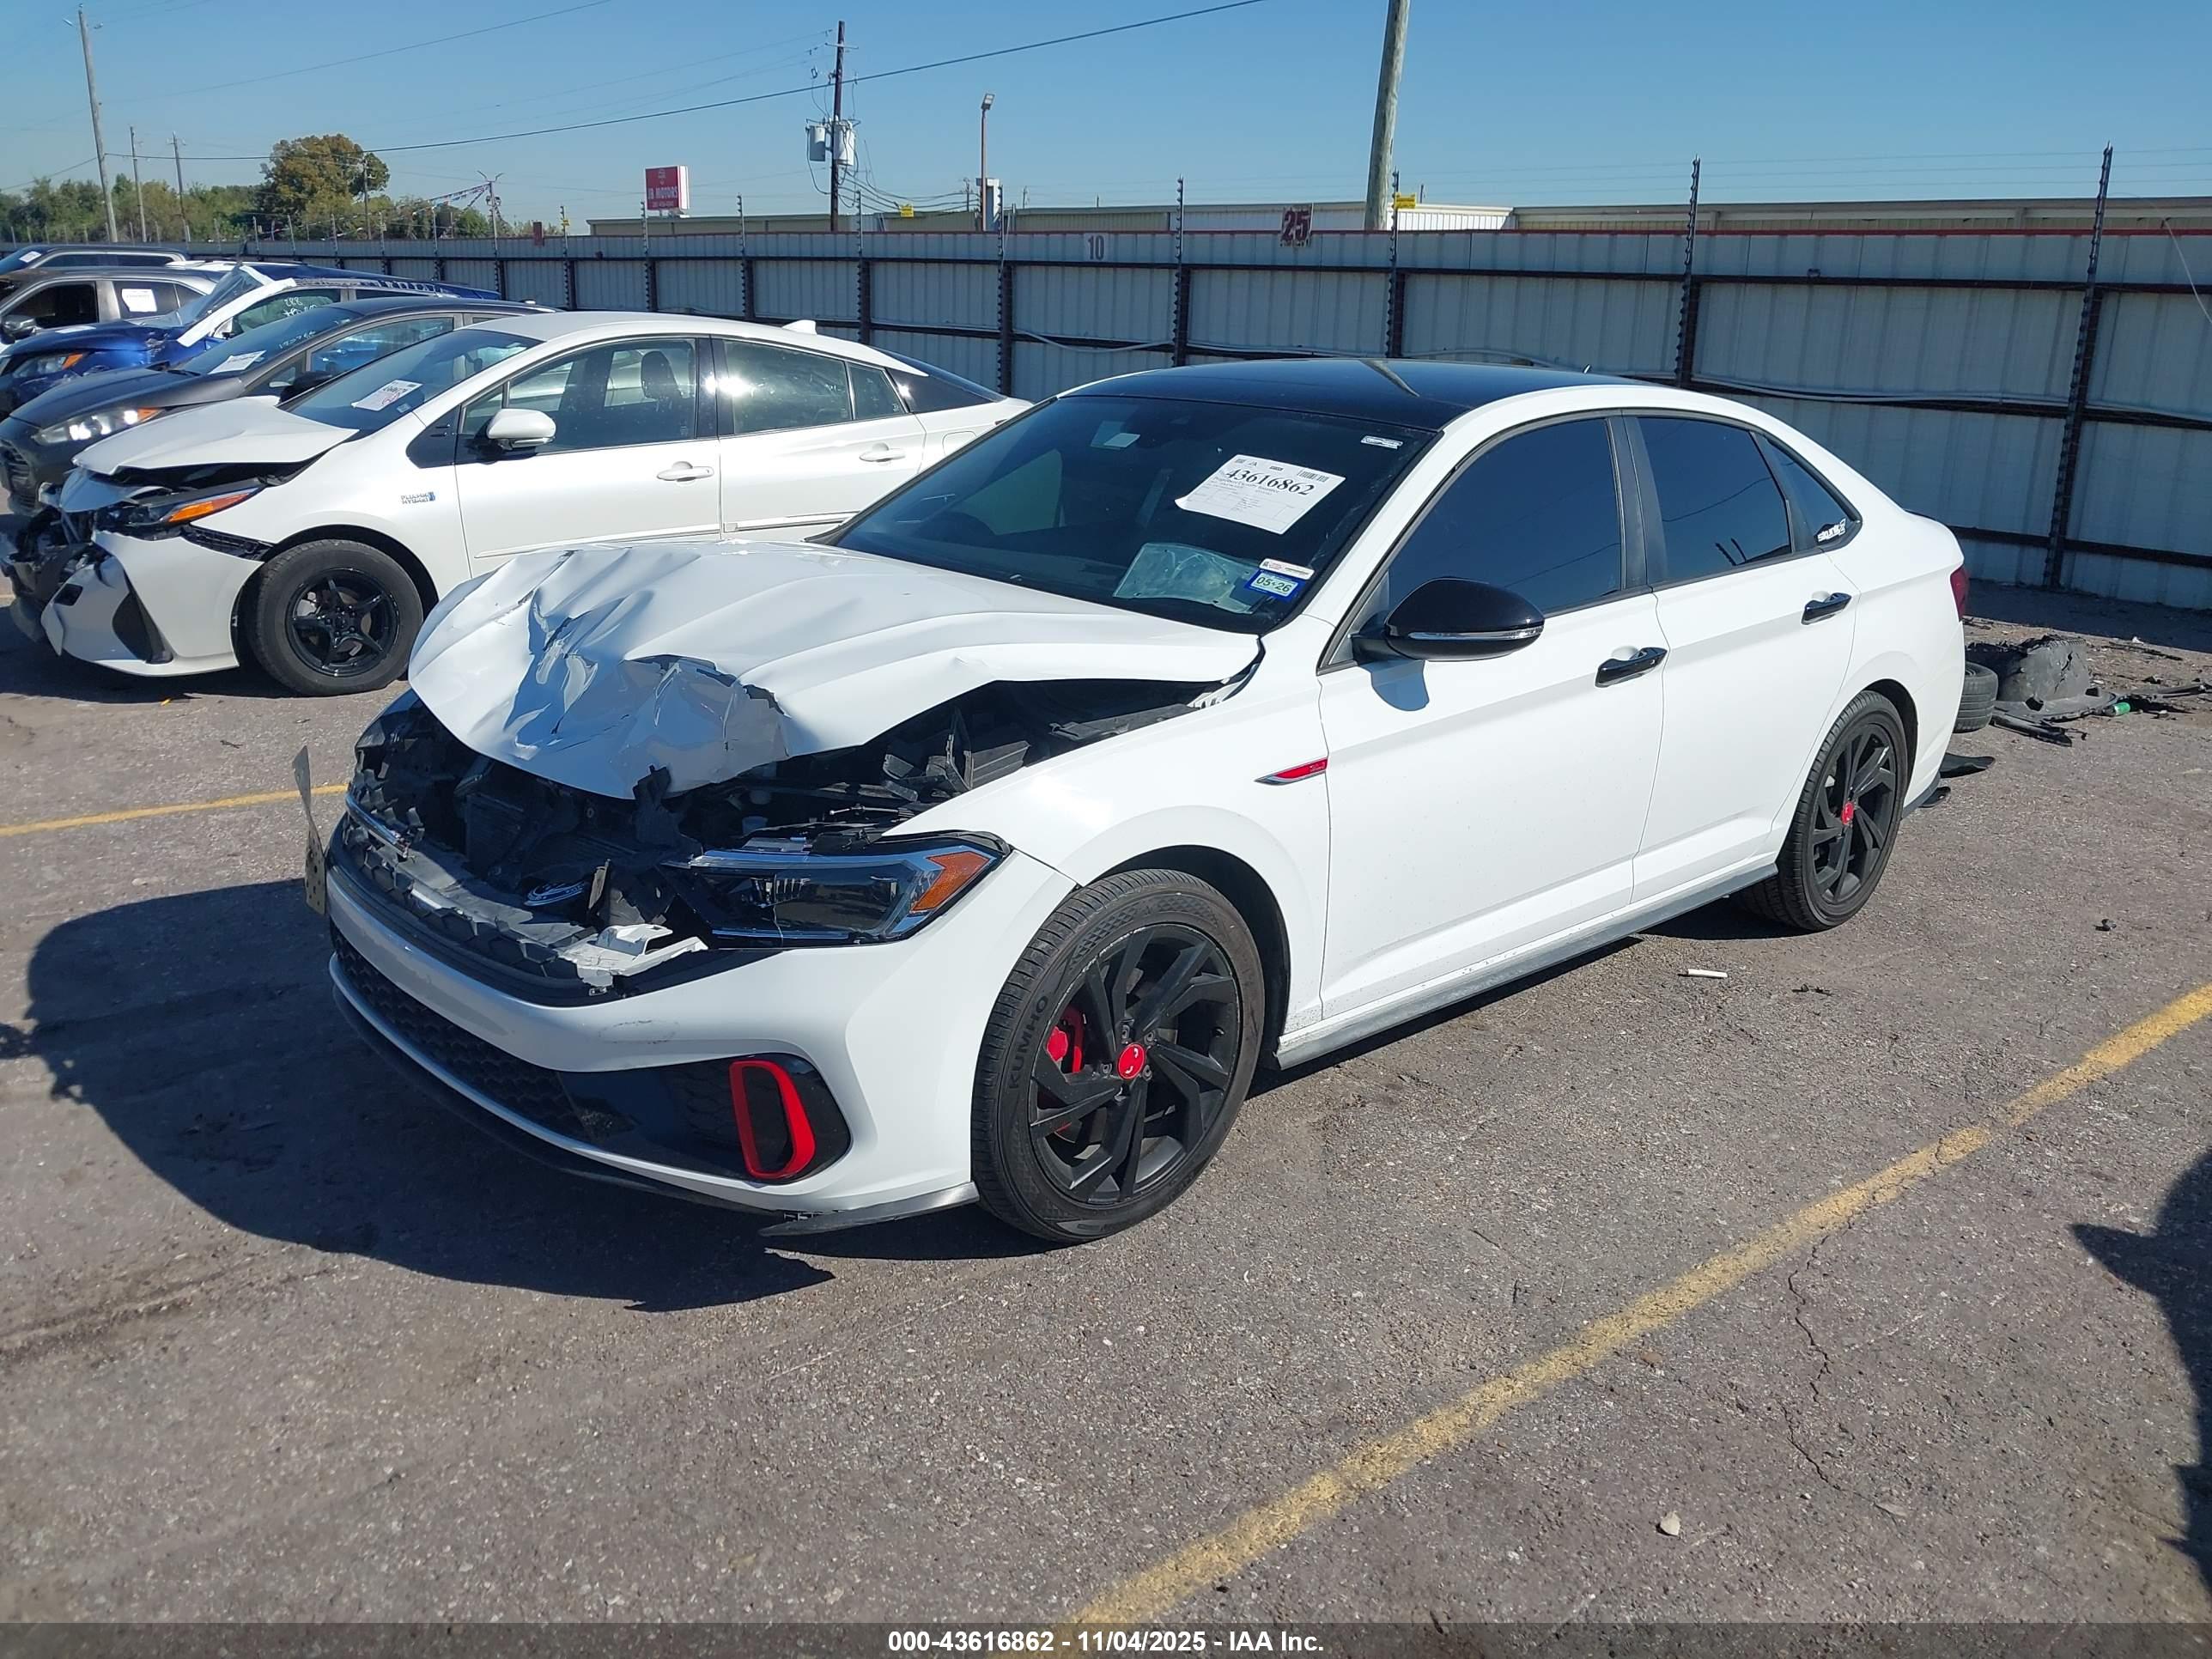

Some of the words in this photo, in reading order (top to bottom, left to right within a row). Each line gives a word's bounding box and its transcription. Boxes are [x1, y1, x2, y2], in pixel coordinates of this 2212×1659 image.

[1282, 210, 1310, 241] 25
[1087, 234, 1105, 260] 10
[1225, 467, 1316, 495] 43616862
[1008, 995, 1048, 1090] KUMHO
